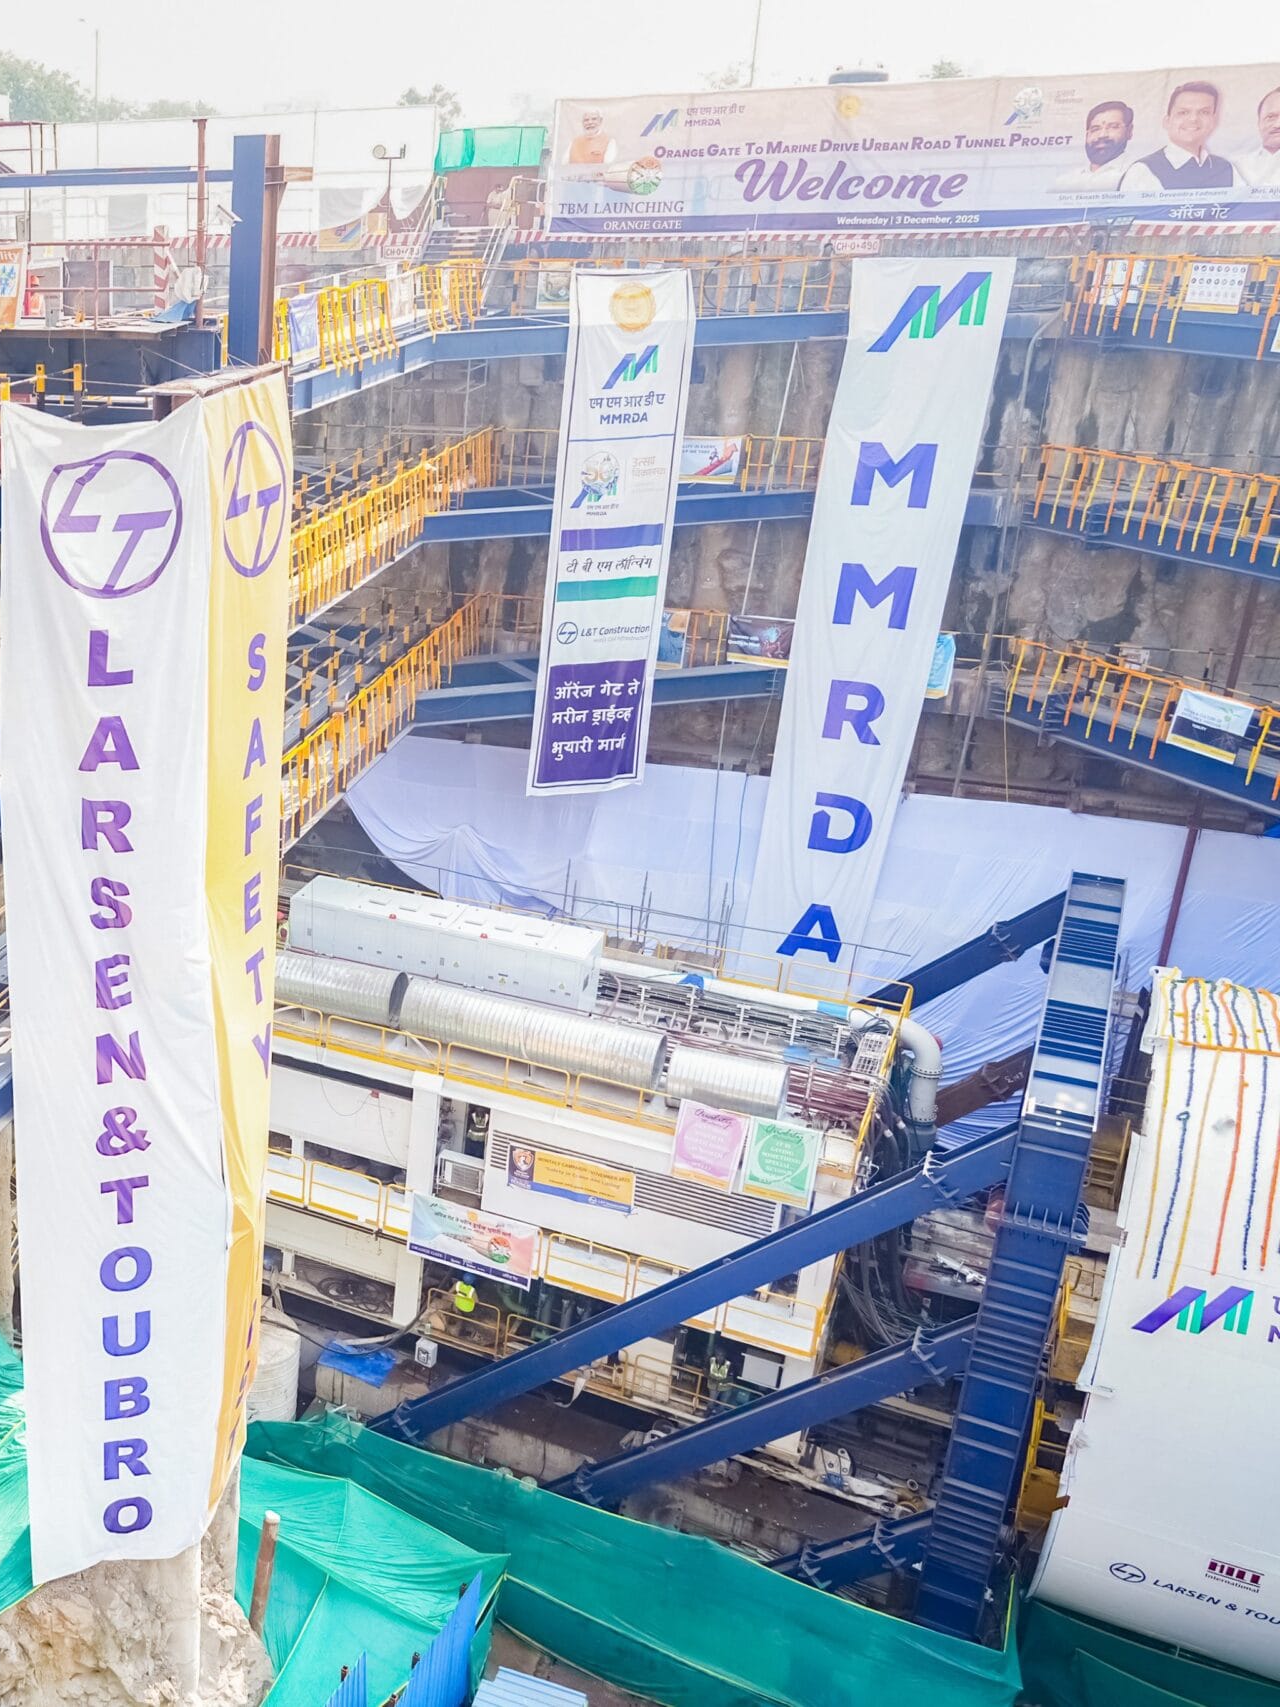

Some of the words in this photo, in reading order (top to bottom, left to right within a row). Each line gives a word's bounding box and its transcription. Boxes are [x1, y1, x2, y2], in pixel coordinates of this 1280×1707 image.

[684, 118, 721, 127] MMRDA
[707, 144, 740, 157] GATE
[766, 140, 817, 155] MARINE
[820, 138, 859, 153] DRIVE
[861, 138, 909, 152] URBAN
[911, 136, 951, 150] ROAD
[954, 135, 1007, 149] TUNNEL
[1009, 133, 1073, 147] PROJECT
[734, 158, 968, 208] Welcome
[558, 202, 588, 214] TBM
[593, 200, 684, 214] LAUNCHING
[1211, 205, 1231, 219] गेट
[603, 220, 651, 231] ORANGE
[652, 219, 683, 230] GATE
[837, 215, 889, 226] Wednesday
[895, 216, 902, 224] 3
[903, 215, 953, 225] December,
[955, 214, 980, 224] 2025
[589, 397, 604, 409] एम
[606, 396, 621, 408] एम
[623, 395, 643, 408] आर
[644, 391, 655, 406] डी
[655, 393, 666, 405] ए
[599, 412, 649, 425] MMRDA
[566, 558, 578, 573] टी
[596, 560, 613, 573] एम
[580, 628, 597, 637] L&T
[599, 625, 650, 636] Construction
[554, 680, 595, 700] ऑरेंज
[600, 680, 625, 696] गेट
[627, 678, 641, 696] ते
[776, 440, 939, 964] MMRDA
[551, 706, 589, 725] मरीन
[591, 704, 634, 726] ड्राईव्ह
[551, 736, 593, 762] भुयारी
[597, 732, 627, 752] मार्ग
[243, 632, 272, 1080] SAFETY
[1205, 1572, 1260, 1594] International
[1153, 1579, 1221, 1605] LARSEN
[1225, 1603, 1238, 1611] &
